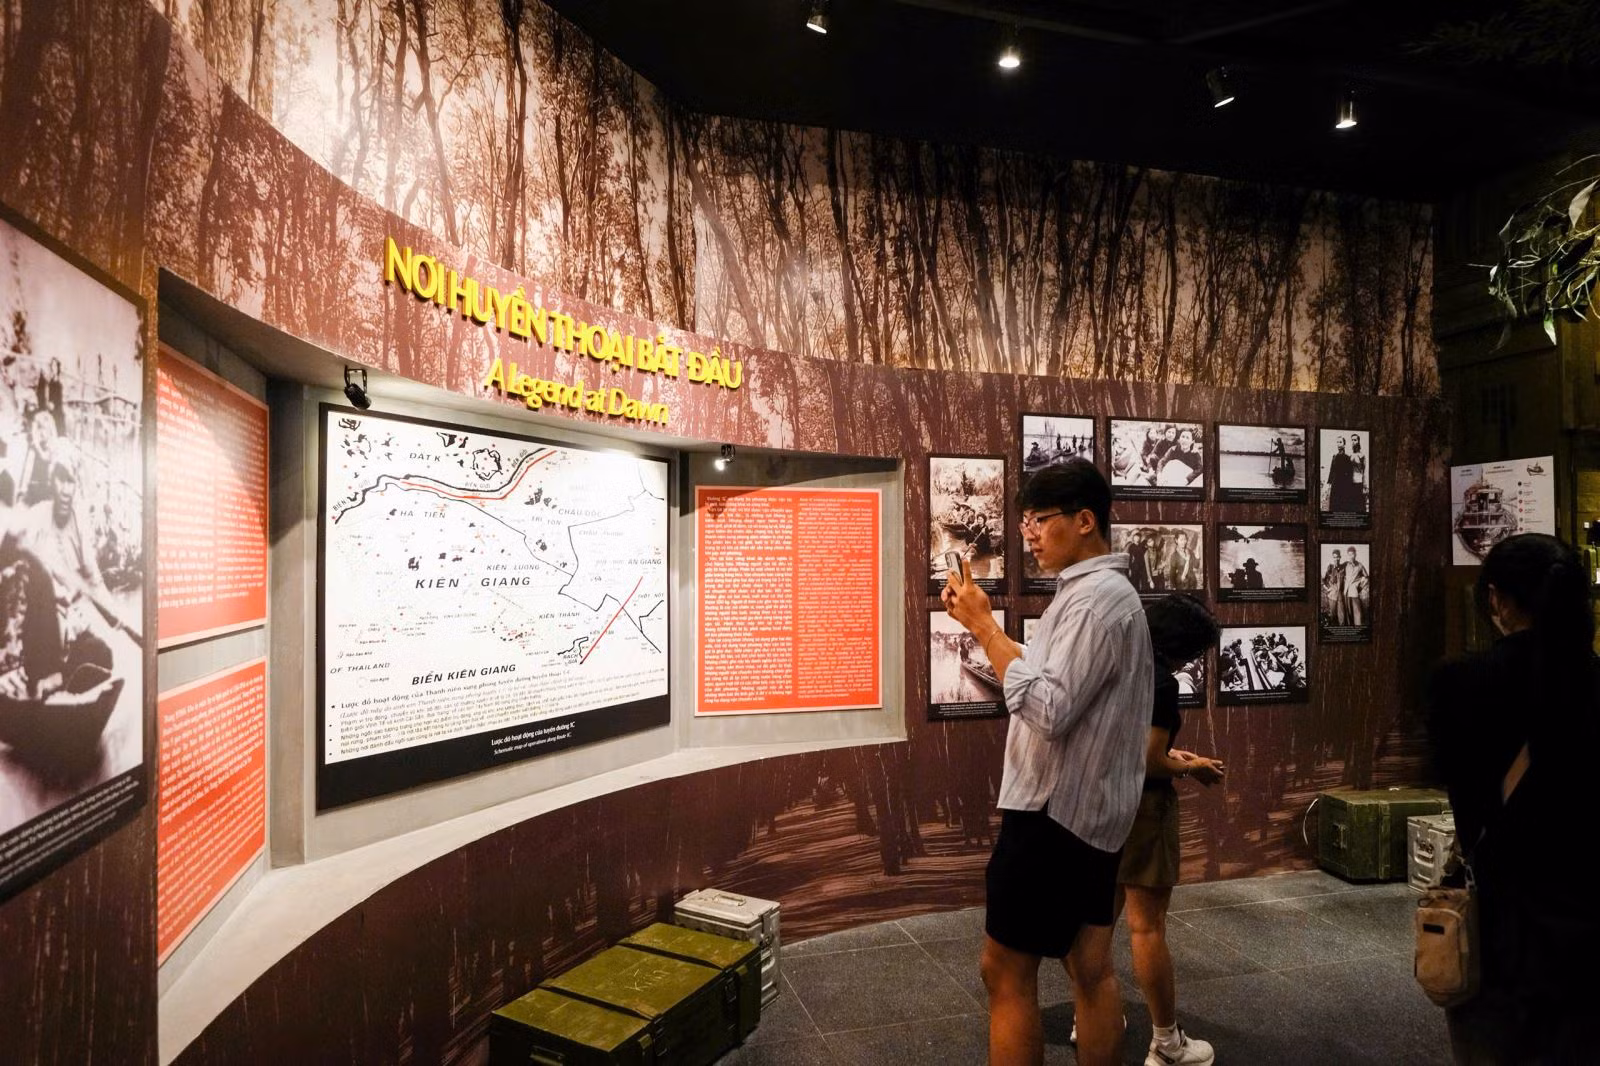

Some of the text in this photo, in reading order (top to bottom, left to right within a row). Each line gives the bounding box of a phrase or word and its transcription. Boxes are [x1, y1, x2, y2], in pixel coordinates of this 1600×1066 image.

[384, 237, 743, 390] NƠI HUYỀN THOẠI BẮT ĐẦU
[485, 358, 670, 425] A Legend at Dawn
[480, 576, 531, 588] GIANG
[347, 663, 390, 672] THAILAND
[412, 664, 517, 686] BIỂN KIÊN GIANG
